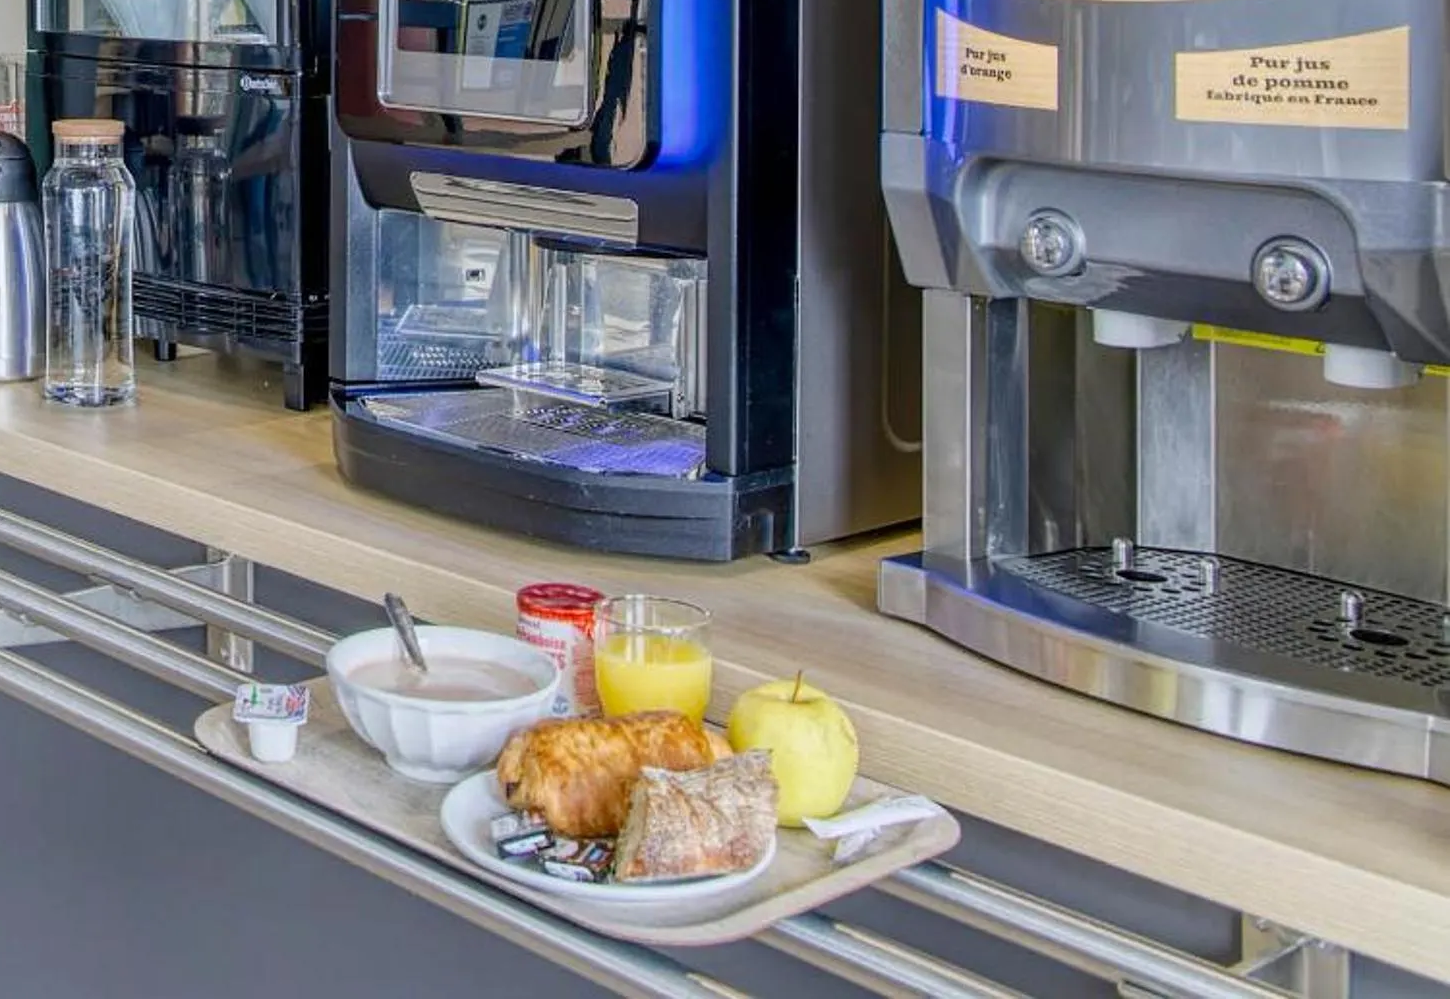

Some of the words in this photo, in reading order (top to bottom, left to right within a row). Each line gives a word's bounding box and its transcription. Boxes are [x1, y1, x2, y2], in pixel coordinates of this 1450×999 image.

[965, 47, 986, 60] Pur
[987, 49, 1007, 64] jus
[1249, 55, 1290, 70] Pur
[1294, 56, 1331, 73] jus
[960, 64, 1012, 82] d'orange
[1232, 74, 1259, 88] de
[1265, 75, 1350, 91] pomme
[1287, 94, 1310, 104] en
[1313, 93, 1379, 107] France
